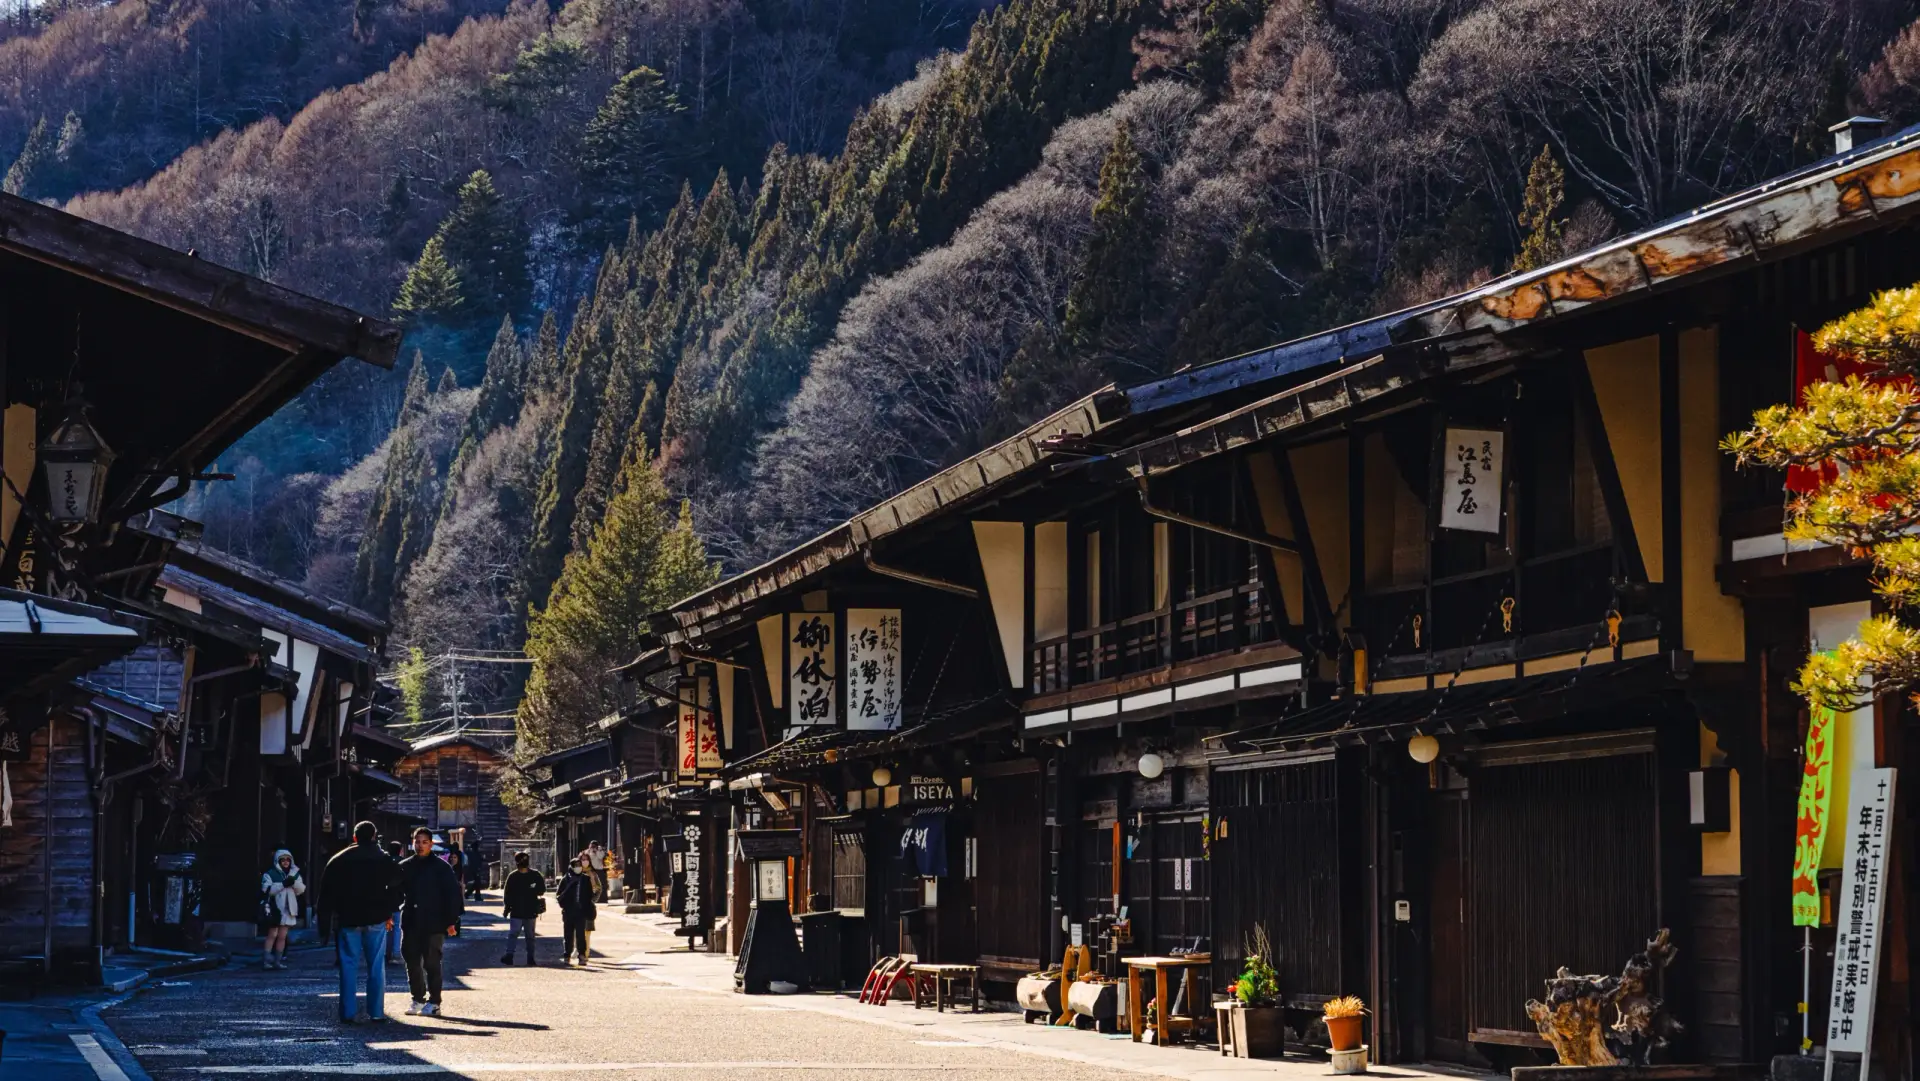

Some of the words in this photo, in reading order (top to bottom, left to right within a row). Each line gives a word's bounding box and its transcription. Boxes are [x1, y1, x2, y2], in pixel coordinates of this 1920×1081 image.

[1480, 440, 1493, 471] 民宿
[792, 616, 836, 720] 御休泊
[859, 627, 882, 718] 伊勢屋
[913, 785, 954, 801] ISEYA
[684, 842, 701, 927] 上問屋史料館
[1841, 806, 1873, 1040] 年末特別警戒実施中
